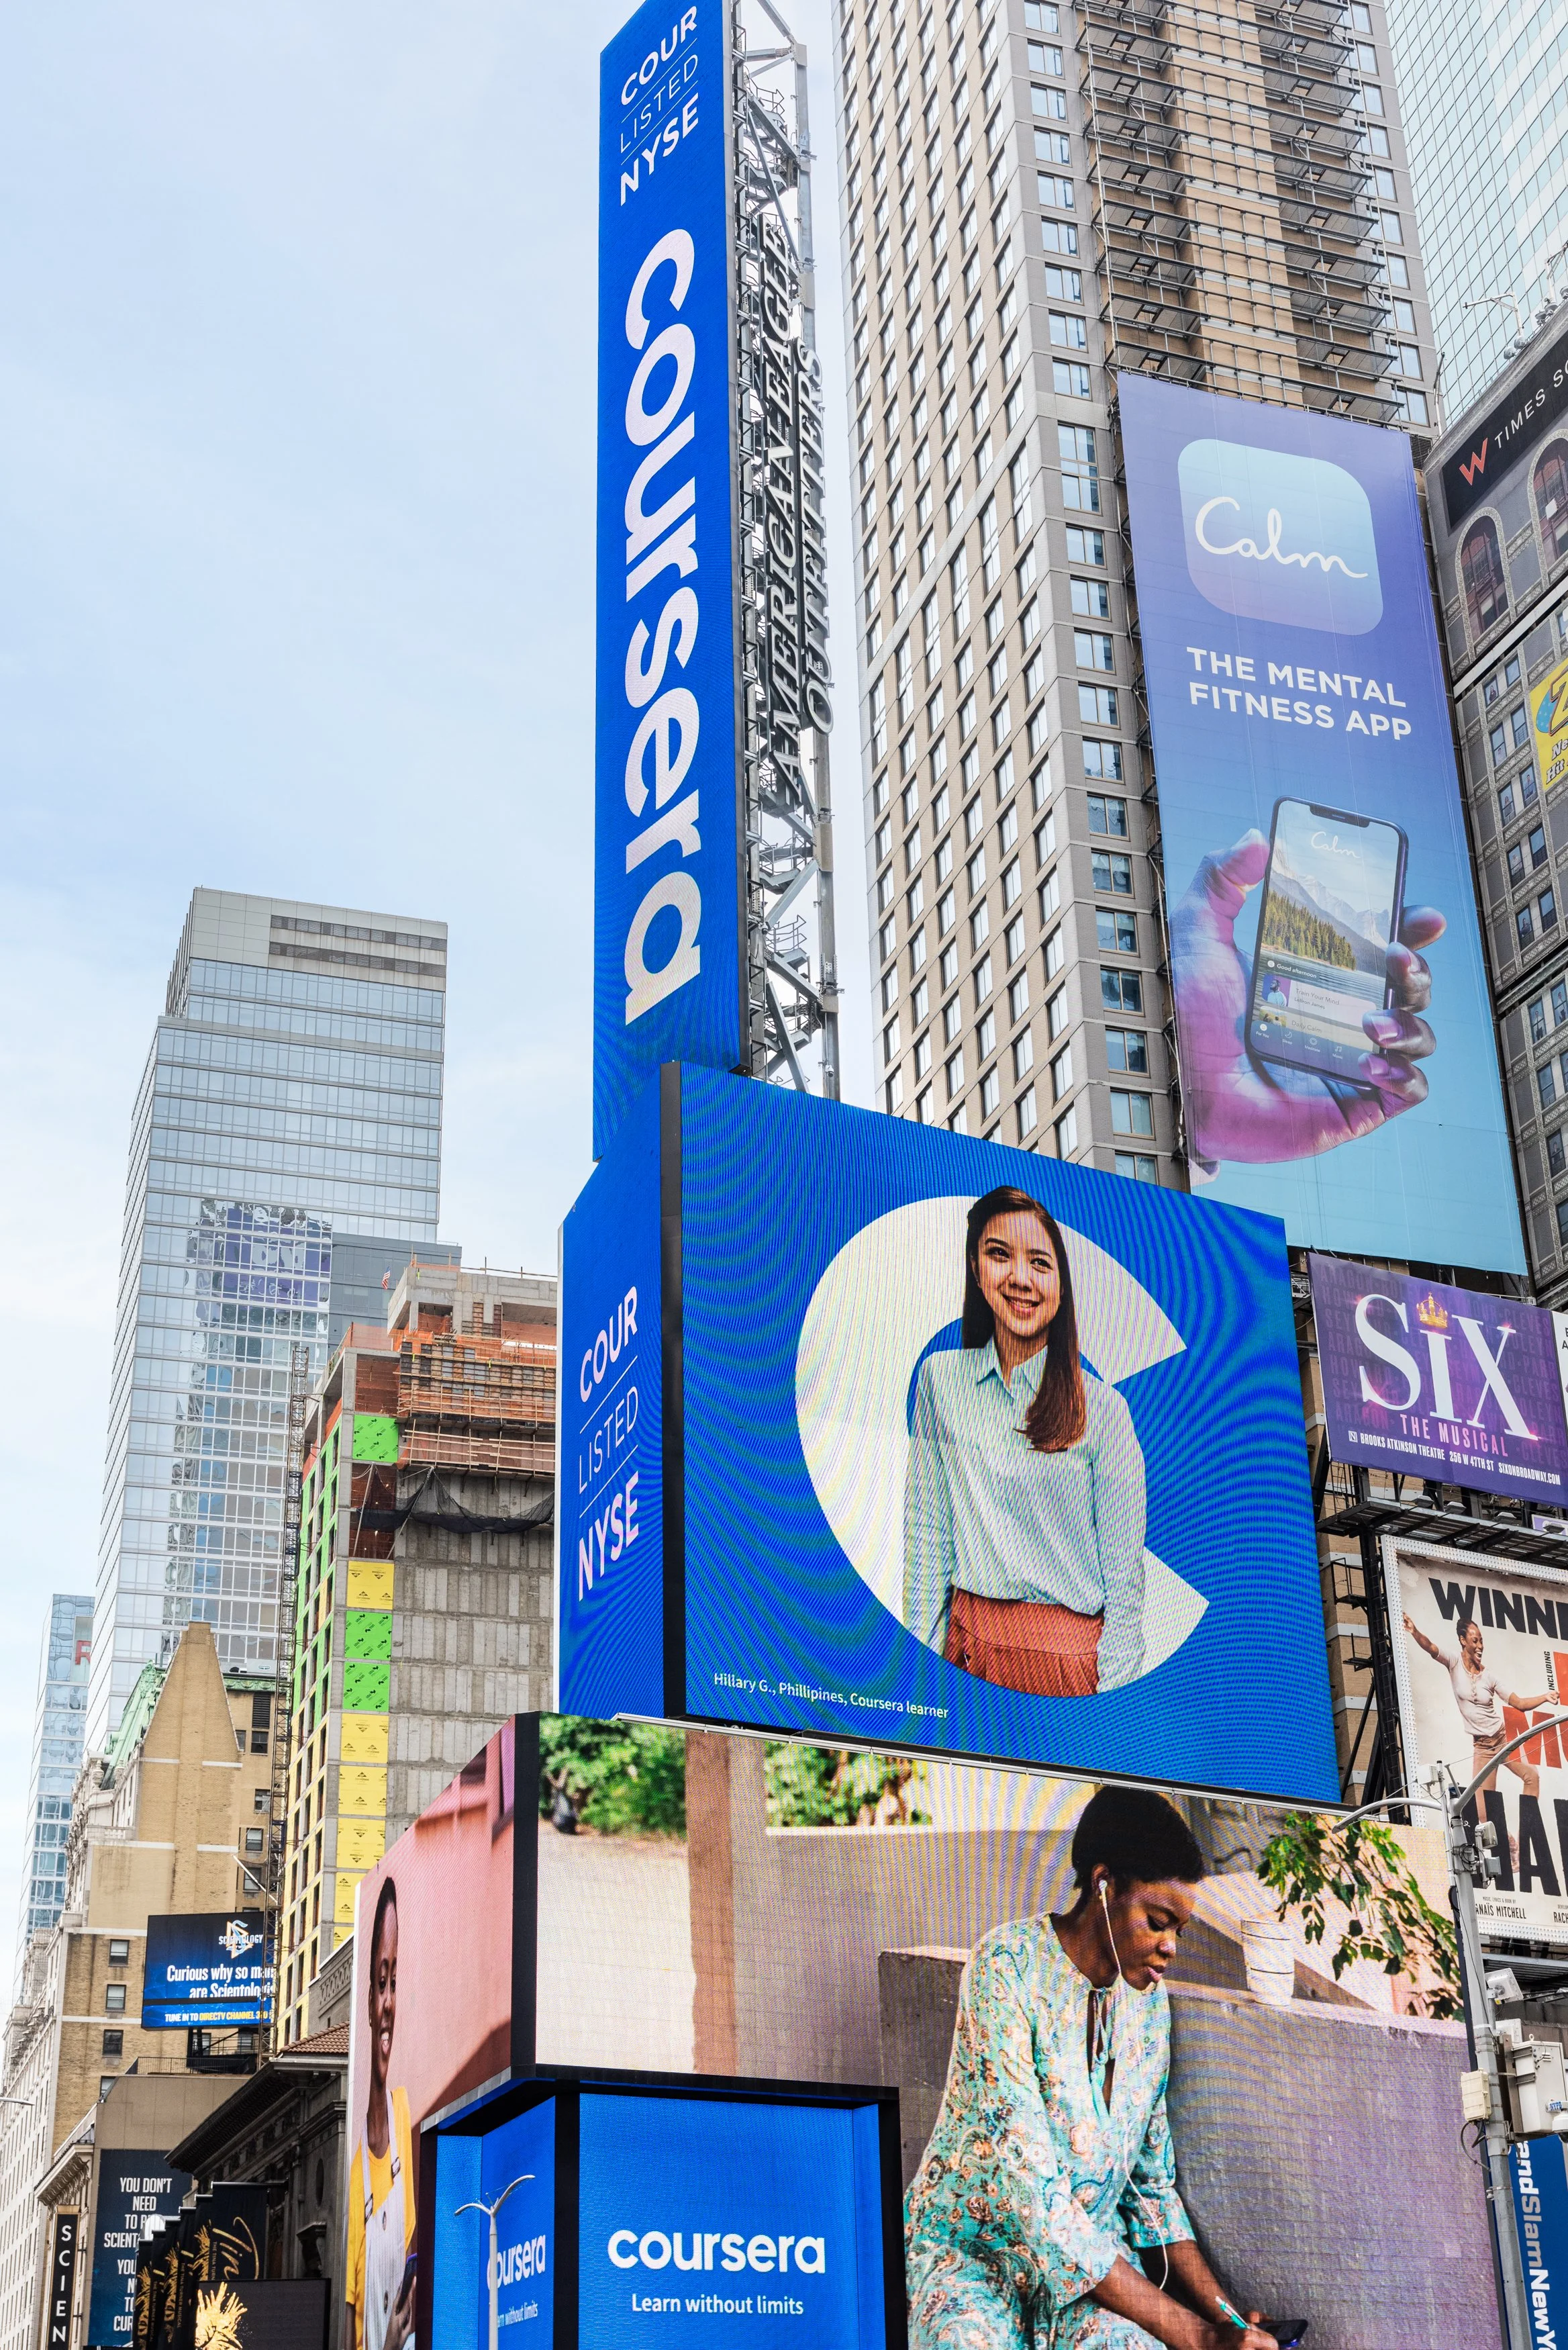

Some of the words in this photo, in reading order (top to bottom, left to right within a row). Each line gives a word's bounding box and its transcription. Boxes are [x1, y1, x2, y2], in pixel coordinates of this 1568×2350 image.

[621, 5, 697, 105] COUR
[621, 54, 698, 154] LISTED
[620, 92, 699, 207] NYSE
[759, 212, 793, 427] EAGLE
[1459, 437, 1488, 485] W
[1495, 389, 1545, 449] TIMES
[794, 336, 834, 735] OUTFITTERS
[1195, 496, 1369, 578] Calm
[625, 228, 701, 1026] coursera
[763, 407, 802, 804] AMERICAN
[1186, 647, 1256, 682] THE
[1267, 661, 1406, 708] MENTAL
[1189, 682, 1334, 728] FITNESS
[1345, 710, 1412, 741] APP
[1546, 759, 1565, 785] Hit
[1310, 831, 1361, 859] Calm
[1277, 963, 1291, 972] Good
[1292, 968, 1317, 978] afternoon
[1295, 988, 1310, 996] Train
[1311, 992, 1324, 1000] Your
[1325, 996, 1340, 1005] Mind
[579, 1286, 638, 1403] COUR
[1355, 1293, 1538, 1441] SIX
[579, 1386, 638, 1495] LISTED
[1400, 1413, 1430, 1439] THE
[1438, 1423, 1509, 1457] MUSICAL
[1360, 1432, 1385, 1448] BROOKS
[1387, 1438, 1418, 1454] ATKINSON
[1418, 1446, 1445, 1460] THEATRE
[1449, 1451, 1461, 1464] 256
[1463, 1454, 1469, 1465] W
[1470, 1456, 1485, 1469] 47TH
[1486, 1460, 1494, 1472] ST
[1498, 1462, 1561, 1486] SIXONBROADWAY.COM
[579, 1470, 639, 1602] NYSE
[1544, 1650, 1555, 1691] INCLUDING
[714, 1673, 756, 1693] Hillary
[759, 1680, 776, 1696] G.,
[779, 1682, 848, 1706] Phillipines,
[850, 1693, 903, 1712] Coursera
[906, 1701, 949, 1719] learner
[1496, 1906, 1527, 1919] MITCHELL
[167, 1965, 208, 1981] Curious
[211, 1963, 233, 1983] why
[235, 1966, 248, 1979] so
[189, 1987, 207, 1998] are
[164, 2014, 183, 2022] TUNE
[191, 2013, 199, 2021] TO
[199, 2012, 226, 2021] DIRECTV
[226, 2011, 256, 2020] CHANNEL
[1549, 2100, 1562, 2111] NYPD
[119, 2177, 140, 2193] YOU
[142, 2177, 172, 2193] DON'T
[132, 2196, 156, 2211] NEED
[104, 2232, 139, 2248] SCIENT
[125, 2214, 138, 2229] TO
[487, 2235, 546, 2290] oursera
[607, 2229, 826, 2274] coursera
[505, 2304, 524, 2326] without
[524, 2300, 538, 2320] limits
[632, 2293, 681, 2312] Learn
[685, 2294, 752, 2314] without
[757, 2295, 803, 2314] limits
